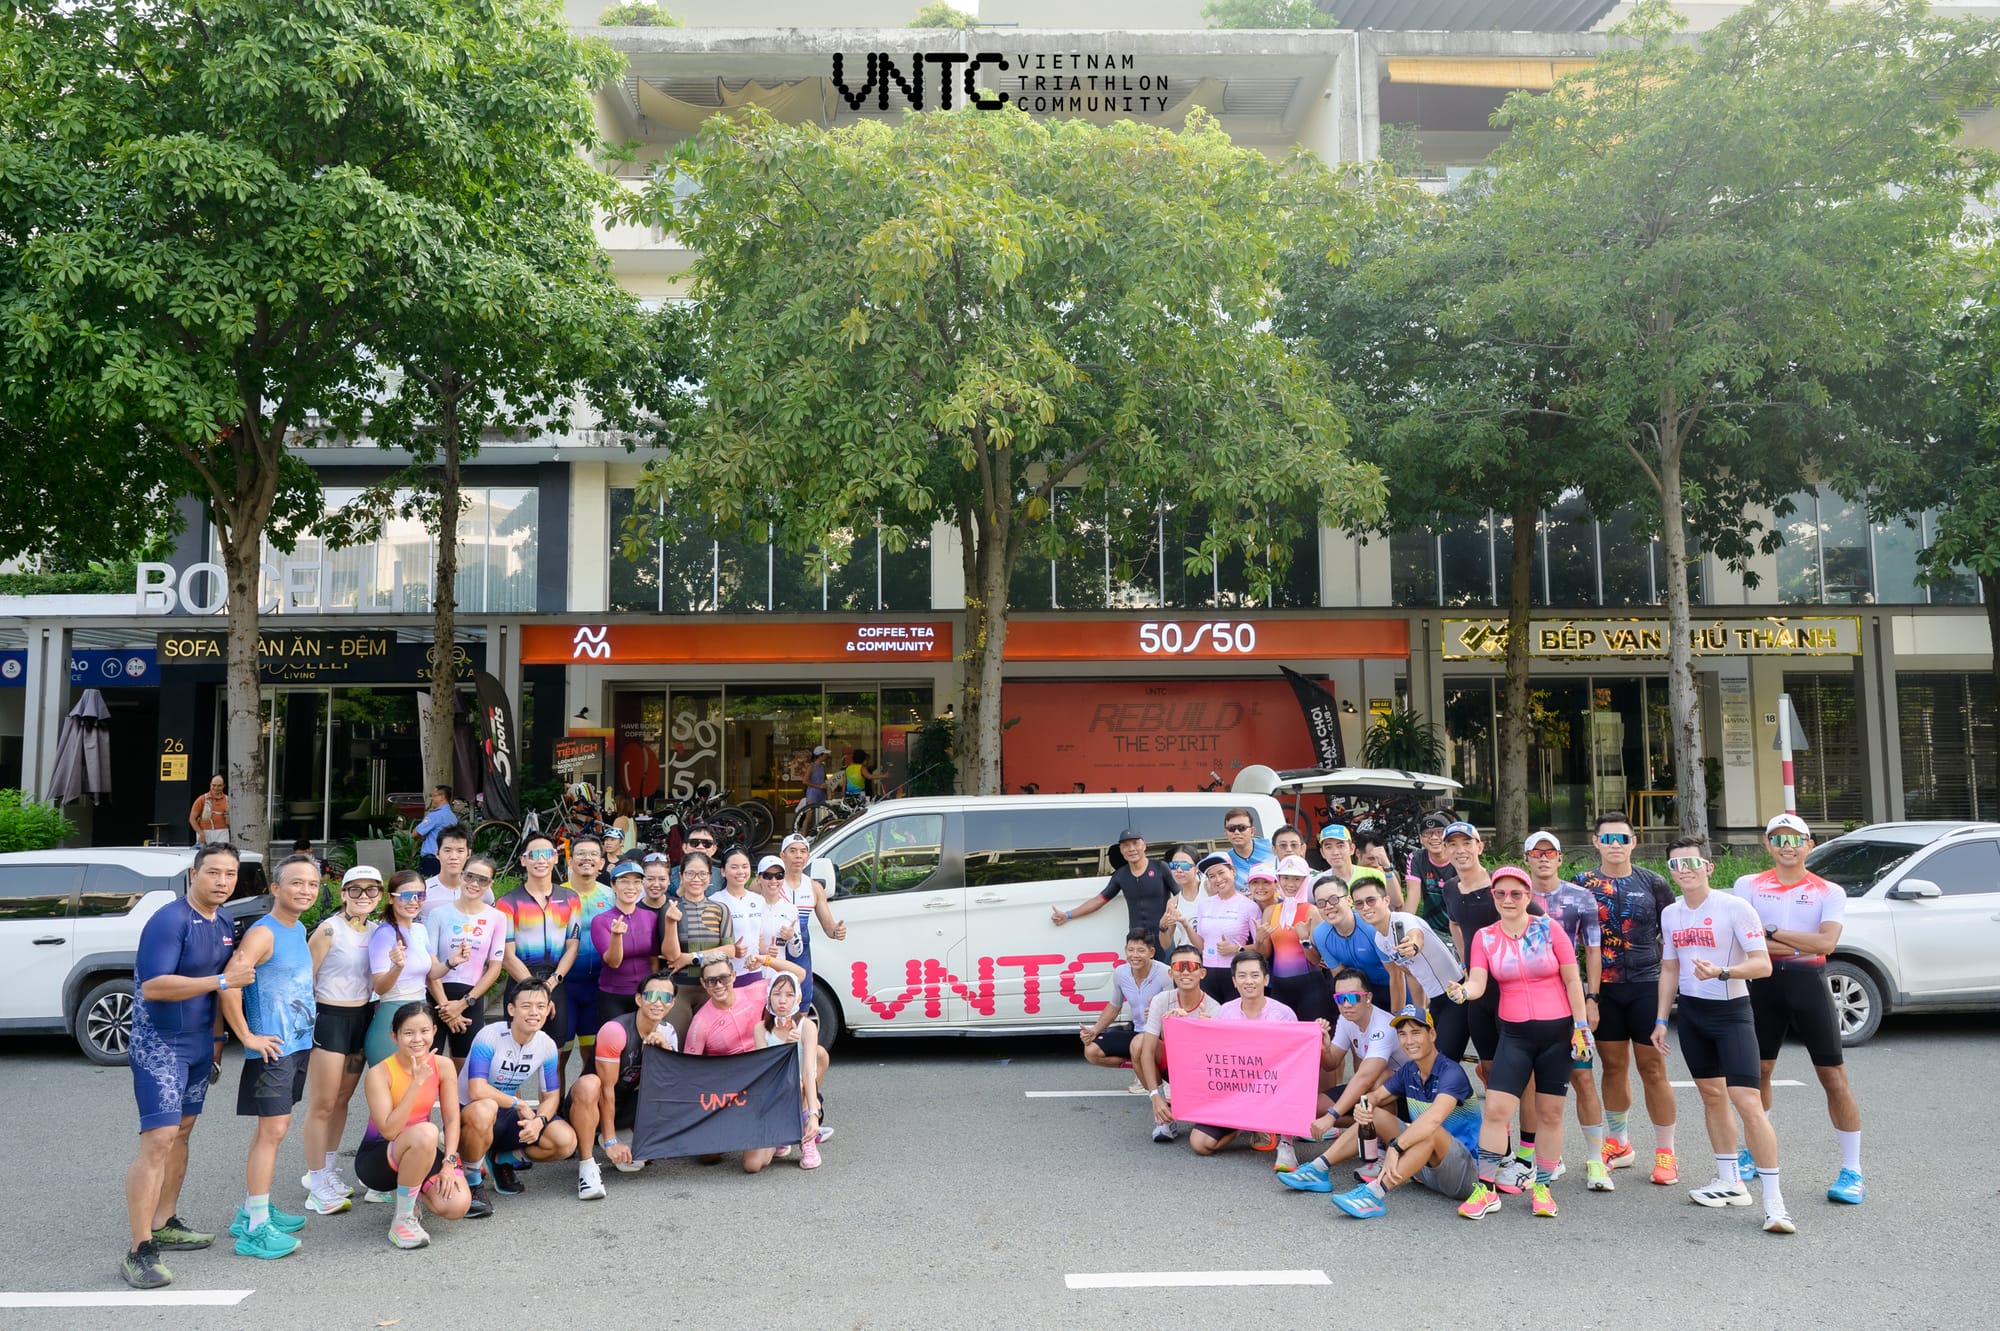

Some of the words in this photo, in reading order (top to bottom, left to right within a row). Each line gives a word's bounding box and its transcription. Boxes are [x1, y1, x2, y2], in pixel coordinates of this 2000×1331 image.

[858, 627, 908, 639] COFFEE,
[910, 627, 934, 638] TEA
[1539, 620, 1596, 651] BẾP
[1602, 629, 1661, 654] VẠN
[1667, 620, 1728, 649] HÚ
[1733, 619, 1837, 649] THÀNH
[164, 639, 221, 657] SOFA
[290, 635, 321, 656] ĂN
[340, 634, 387, 659] ĐỆM
[857, 641, 934, 652] COMMUNITY
[284, 672, 316, 680] LIVING
[1144, 687, 1168, 696] VNTC
[1087, 702, 1244, 733] REBUILD
[1766, 714, 1777, 724] 18
[164, 737, 185, 753] 26
[1113, 736, 1150, 753] THE
[1154, 734, 1221, 752] SPIRIT
[851, 951, 1129, 1020] VNTC
[1205, 1053, 1264, 1067] VIETNAM
[1206, 1066, 1279, 1081] TRIATHLON
[1207, 1080, 1279, 1096] COMMUNITY
[699, 1090, 748, 1112] VNTC
